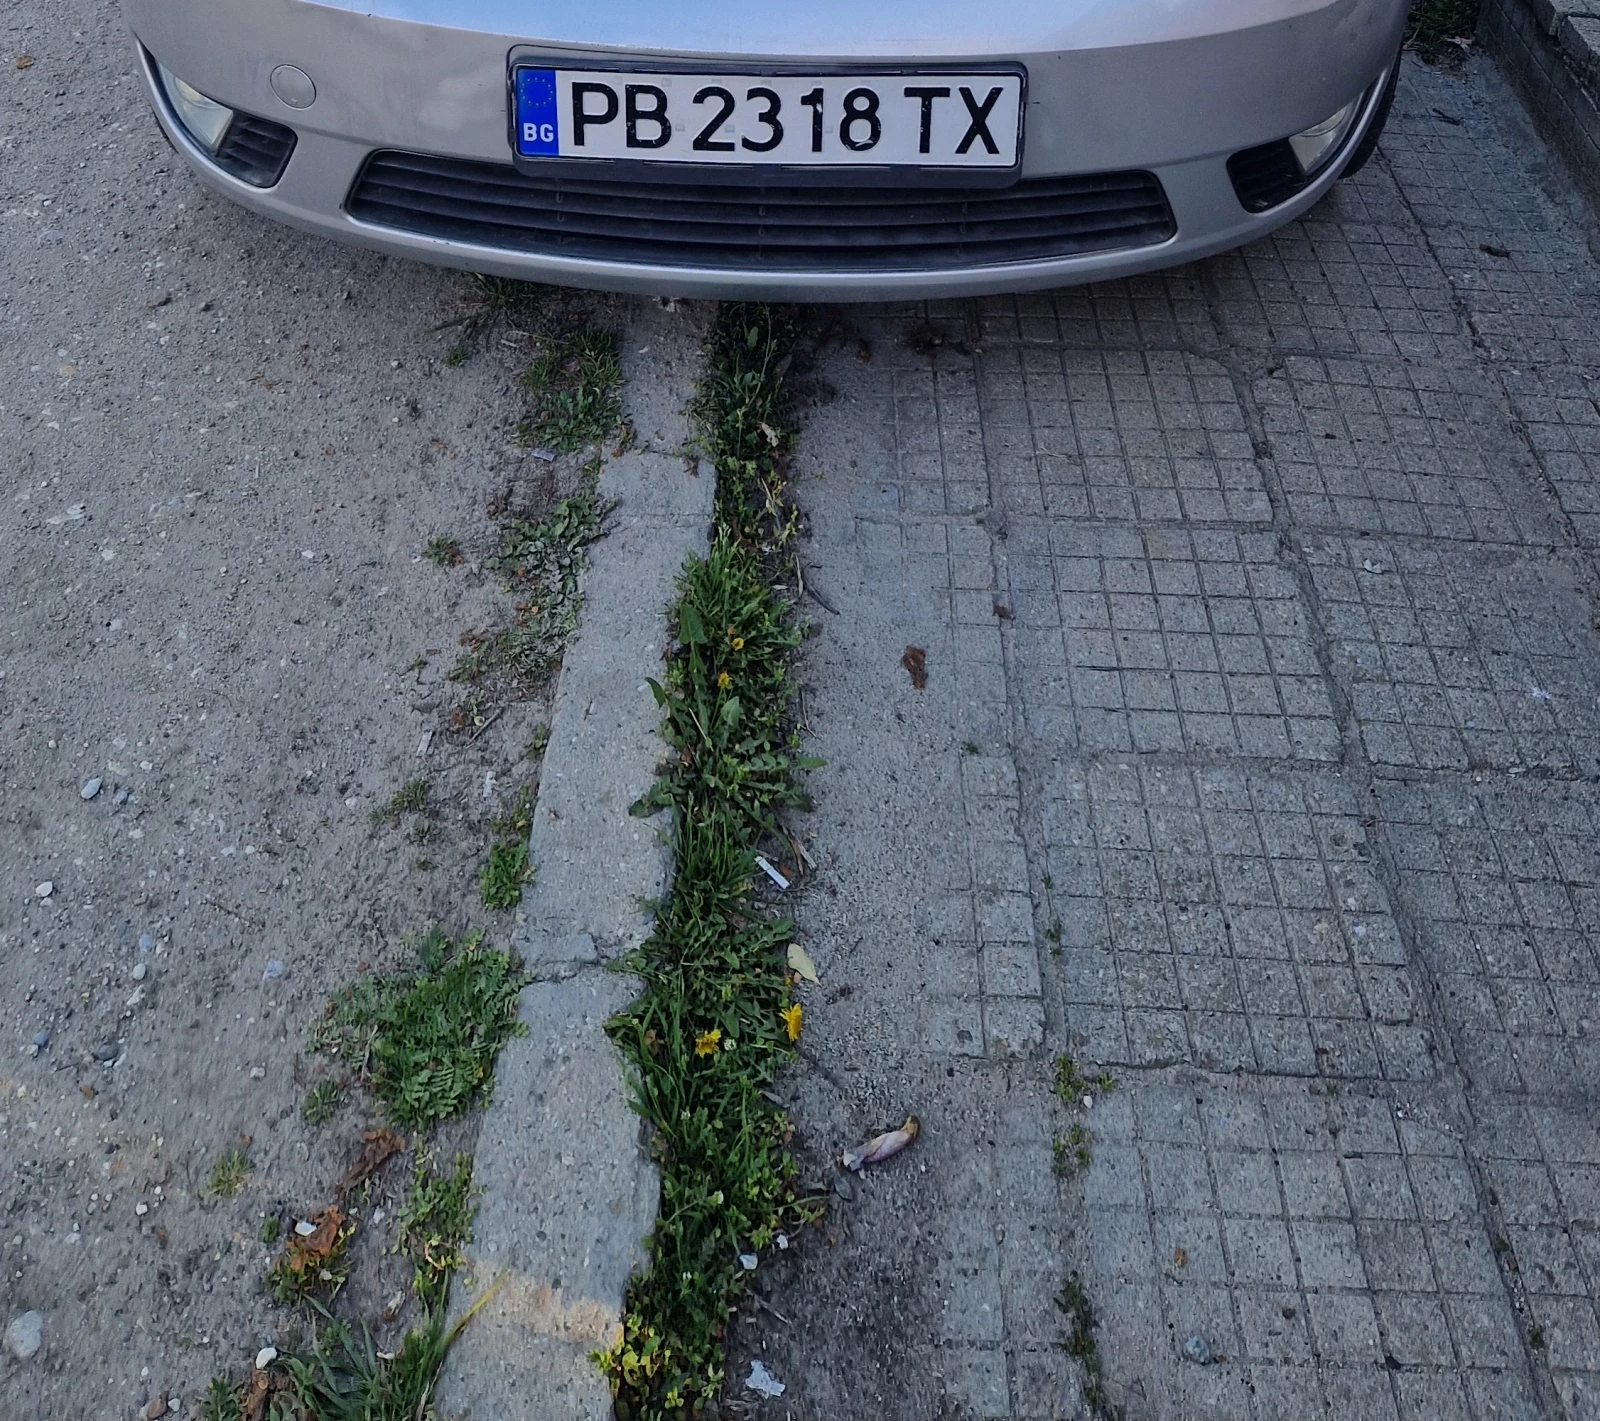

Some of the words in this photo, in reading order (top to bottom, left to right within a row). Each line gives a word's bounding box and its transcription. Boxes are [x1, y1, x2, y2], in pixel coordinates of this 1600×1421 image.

[523, 122, 554, 143] BG
[571, 81, 671, 148] PB
[692, 86, 881, 153] 2318
[903, 86, 1004, 155] TX
